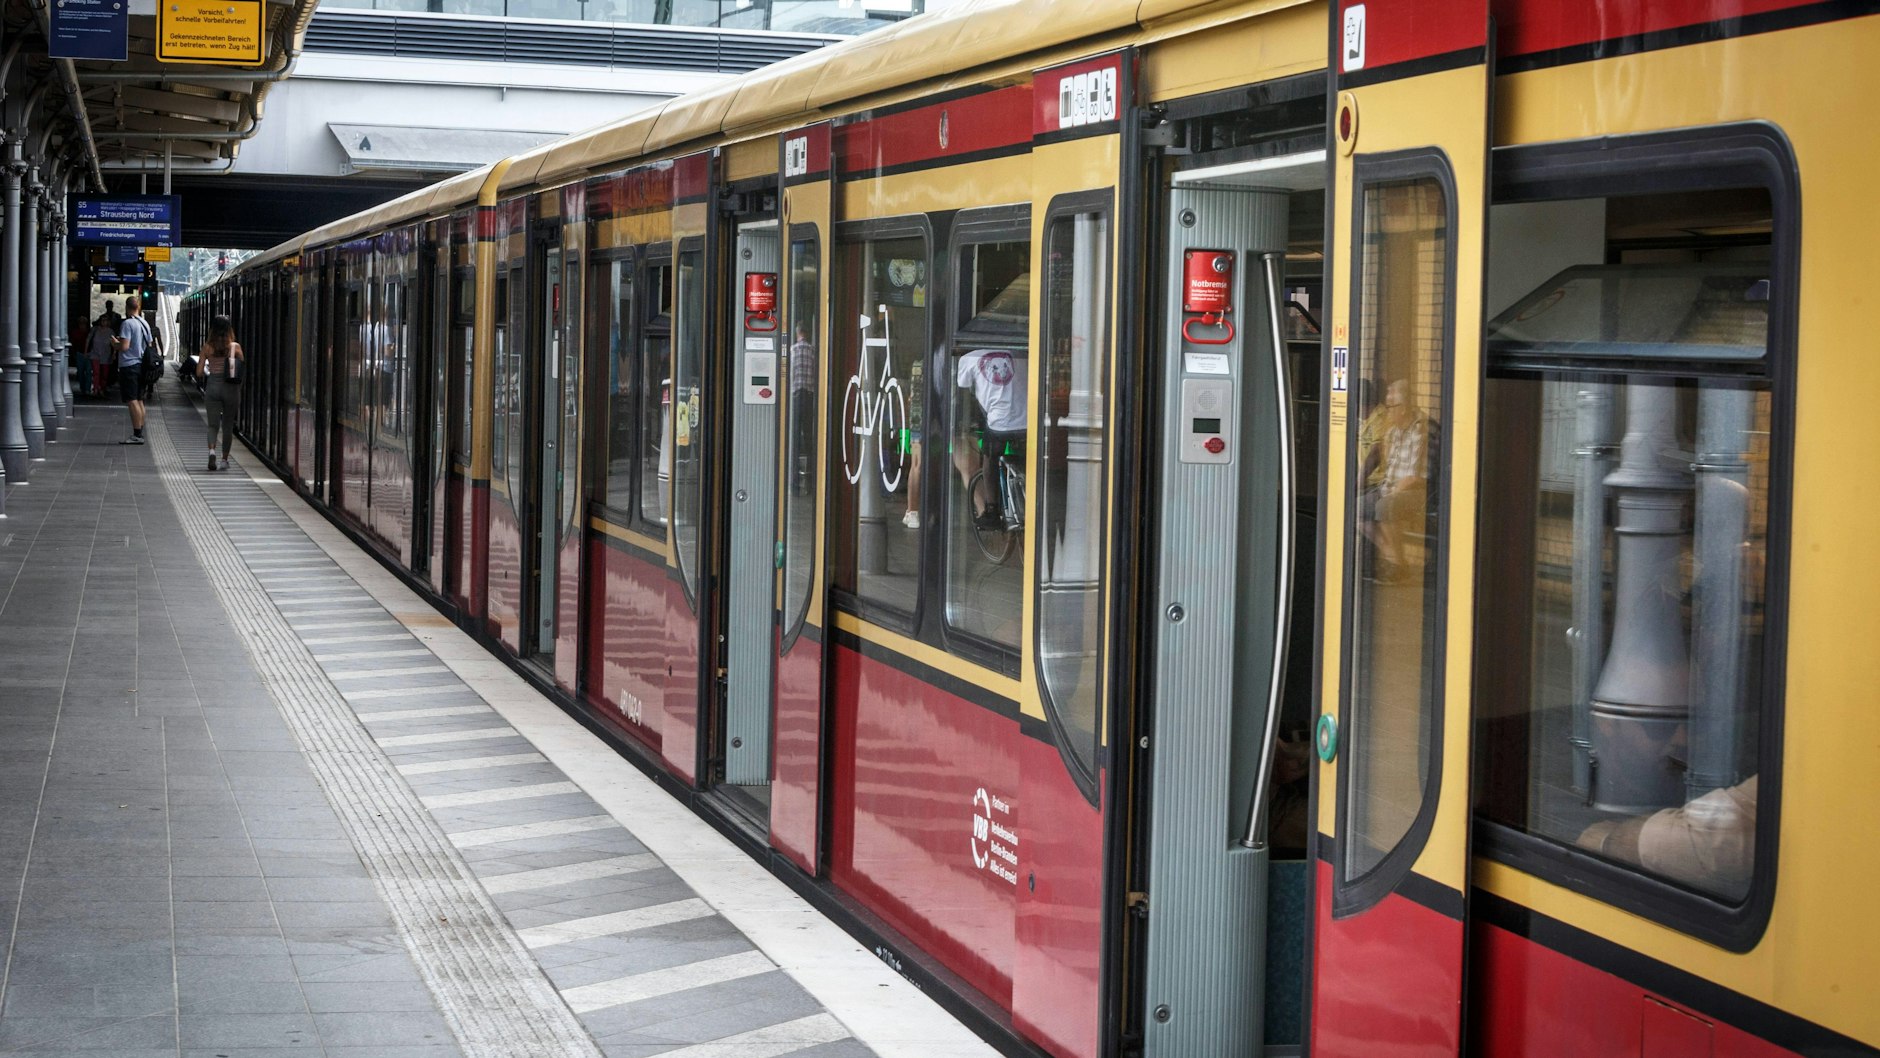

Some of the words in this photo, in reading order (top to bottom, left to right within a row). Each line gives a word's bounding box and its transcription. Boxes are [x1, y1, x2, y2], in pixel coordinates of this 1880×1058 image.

[170, 33, 225, 41] Gekennzeichneten
[100, 210, 137, 219] Strausberg
[1192, 280, 1227, 288] Notbremse
[974, 814, 988, 842] VBB
